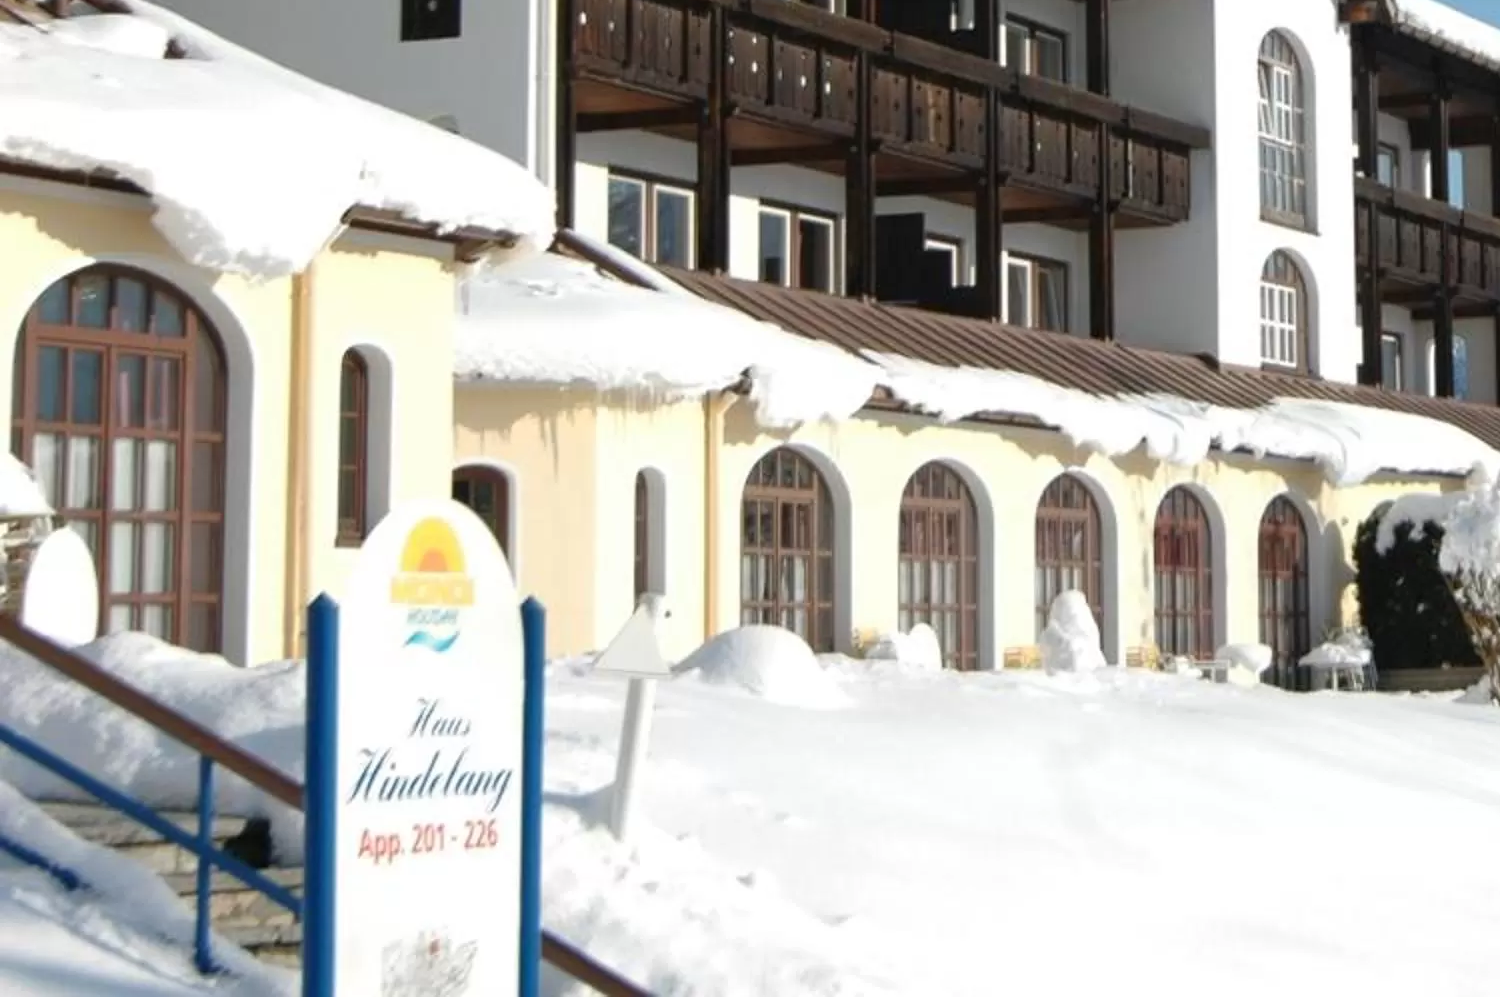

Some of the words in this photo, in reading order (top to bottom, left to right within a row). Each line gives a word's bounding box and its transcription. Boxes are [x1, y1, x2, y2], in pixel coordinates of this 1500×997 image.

[408, 697, 471, 738] Haus
[347, 746, 513, 814] Hindelang
[358, 827, 405, 865] App.
[411, 823, 446, 854] 201
[464, 818, 499, 850] 226
